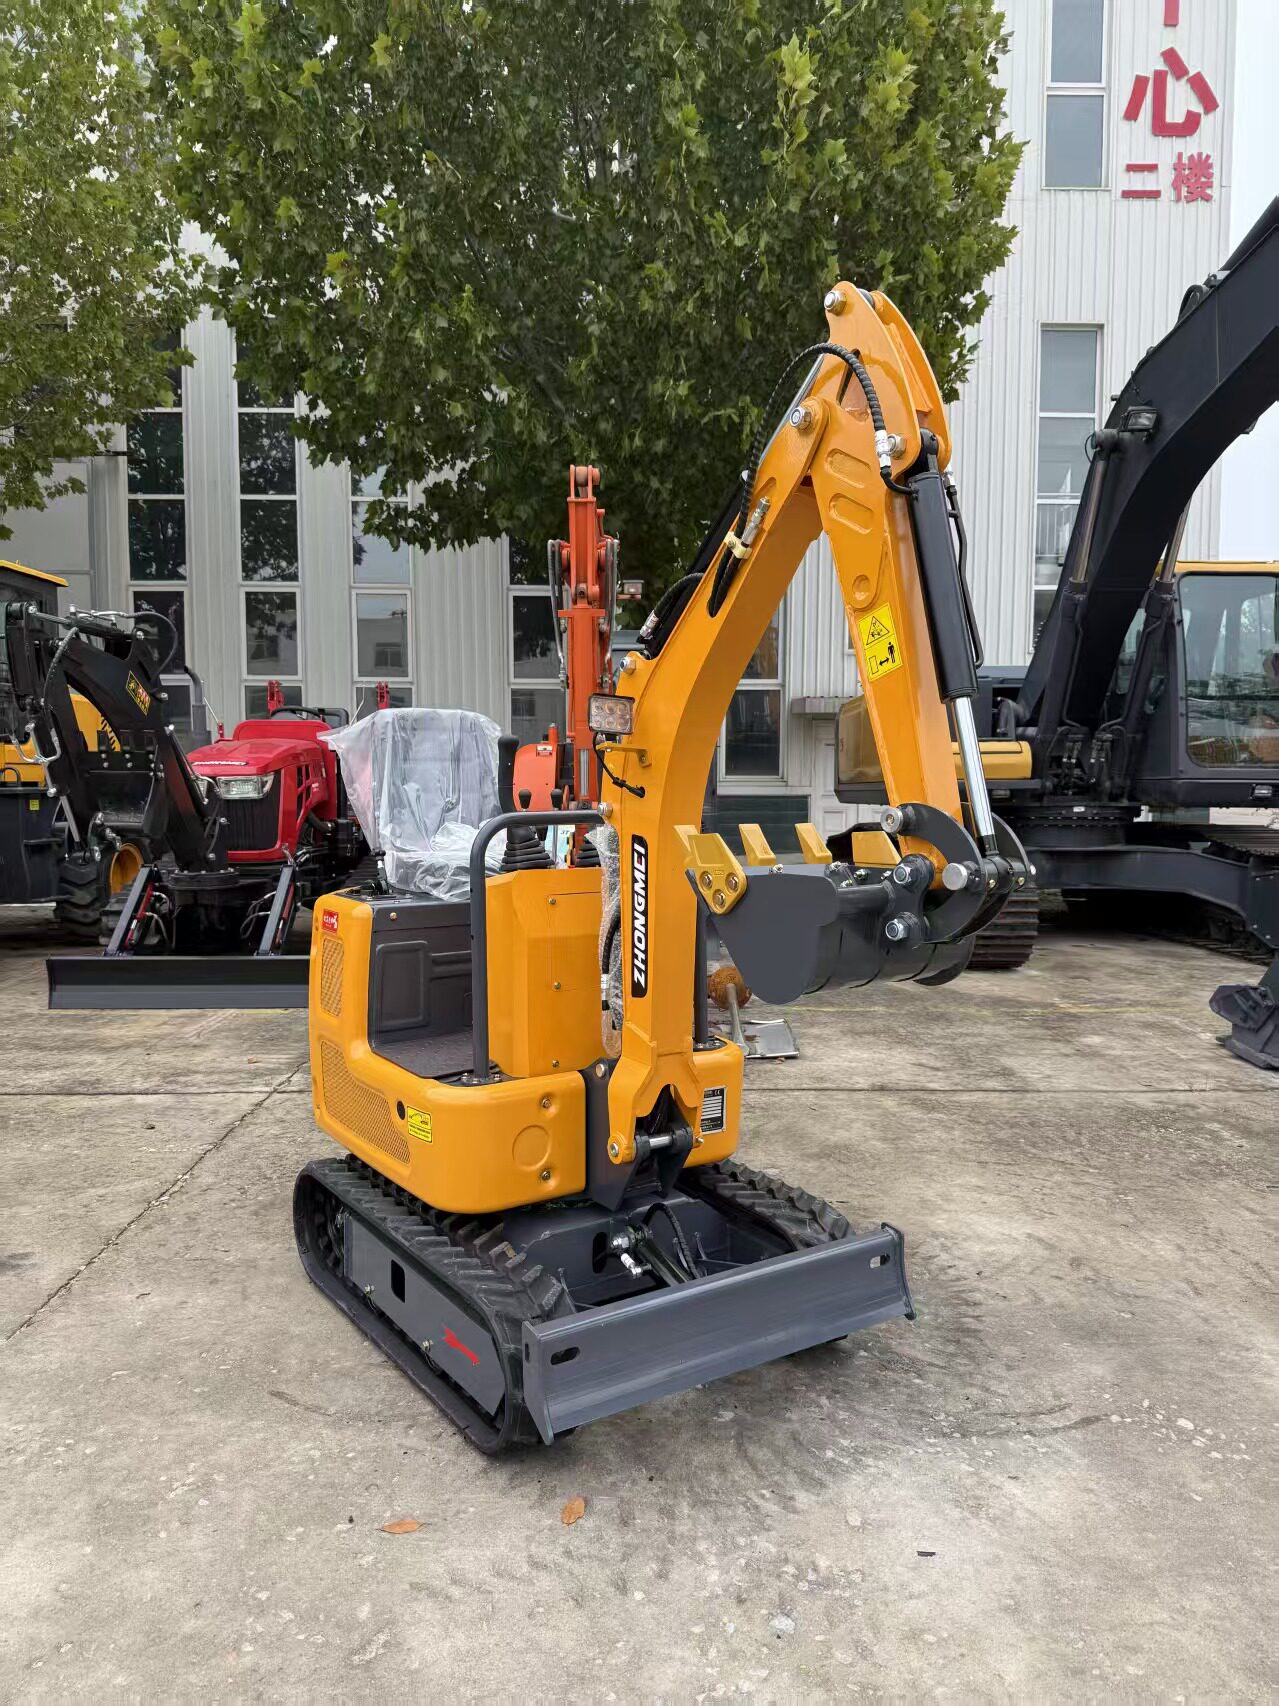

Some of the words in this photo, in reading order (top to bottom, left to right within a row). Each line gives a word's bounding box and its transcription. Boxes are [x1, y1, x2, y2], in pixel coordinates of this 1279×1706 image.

[1123, 0, 1219, 137] 心
[1121, 152, 1214, 203] 二楼
[633, 843, 646, 988] ZHONGMEI
